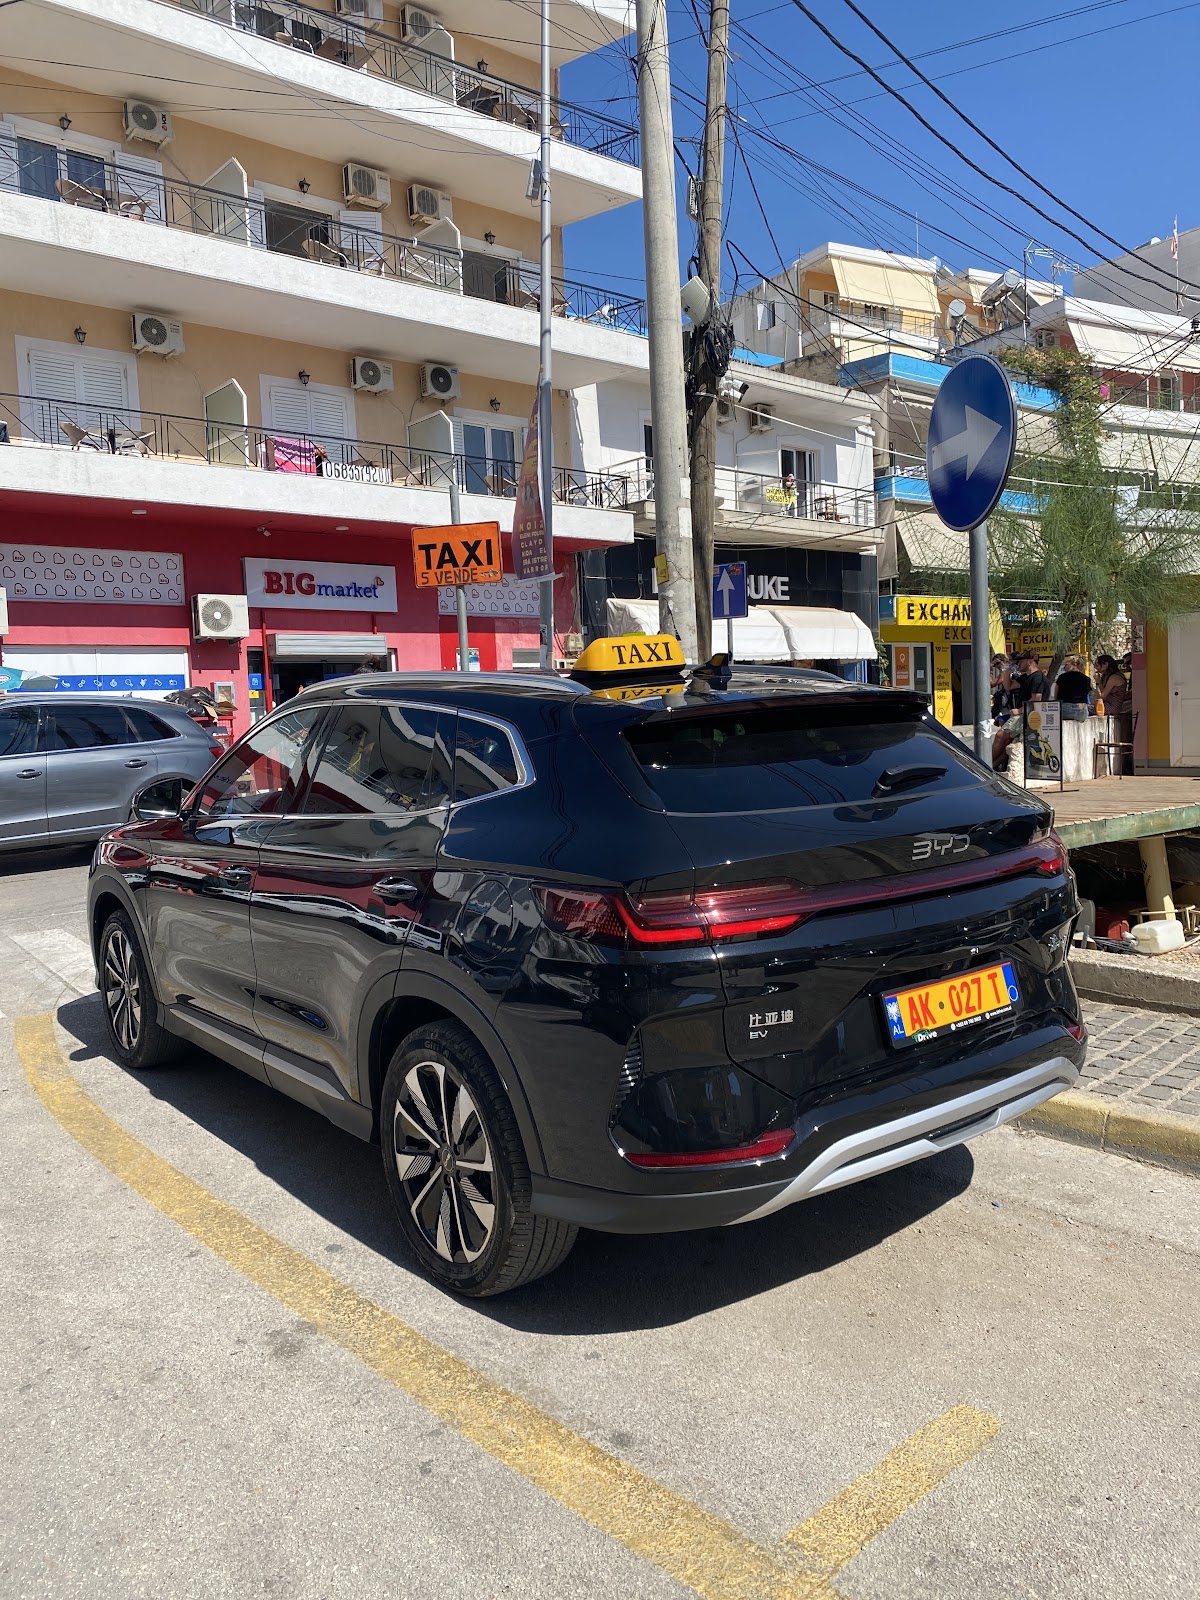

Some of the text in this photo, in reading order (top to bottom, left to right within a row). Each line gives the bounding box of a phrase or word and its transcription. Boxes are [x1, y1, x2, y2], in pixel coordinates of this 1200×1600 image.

[418, 539, 493, 570] TAXI
[421, 568, 478, 585] 5 VENDE
[907, 603, 971, 621] EXCHAN
[612, 642, 673, 665] TAXI
[912, 834, 970, 860] BYD
[908, 972, 1001, 1031] AK 027 T
[749, 1009, 794, 1028] 比亚迪
[749, 1030, 768, 1040] EV
[893, 1025, 904, 1036] AL
